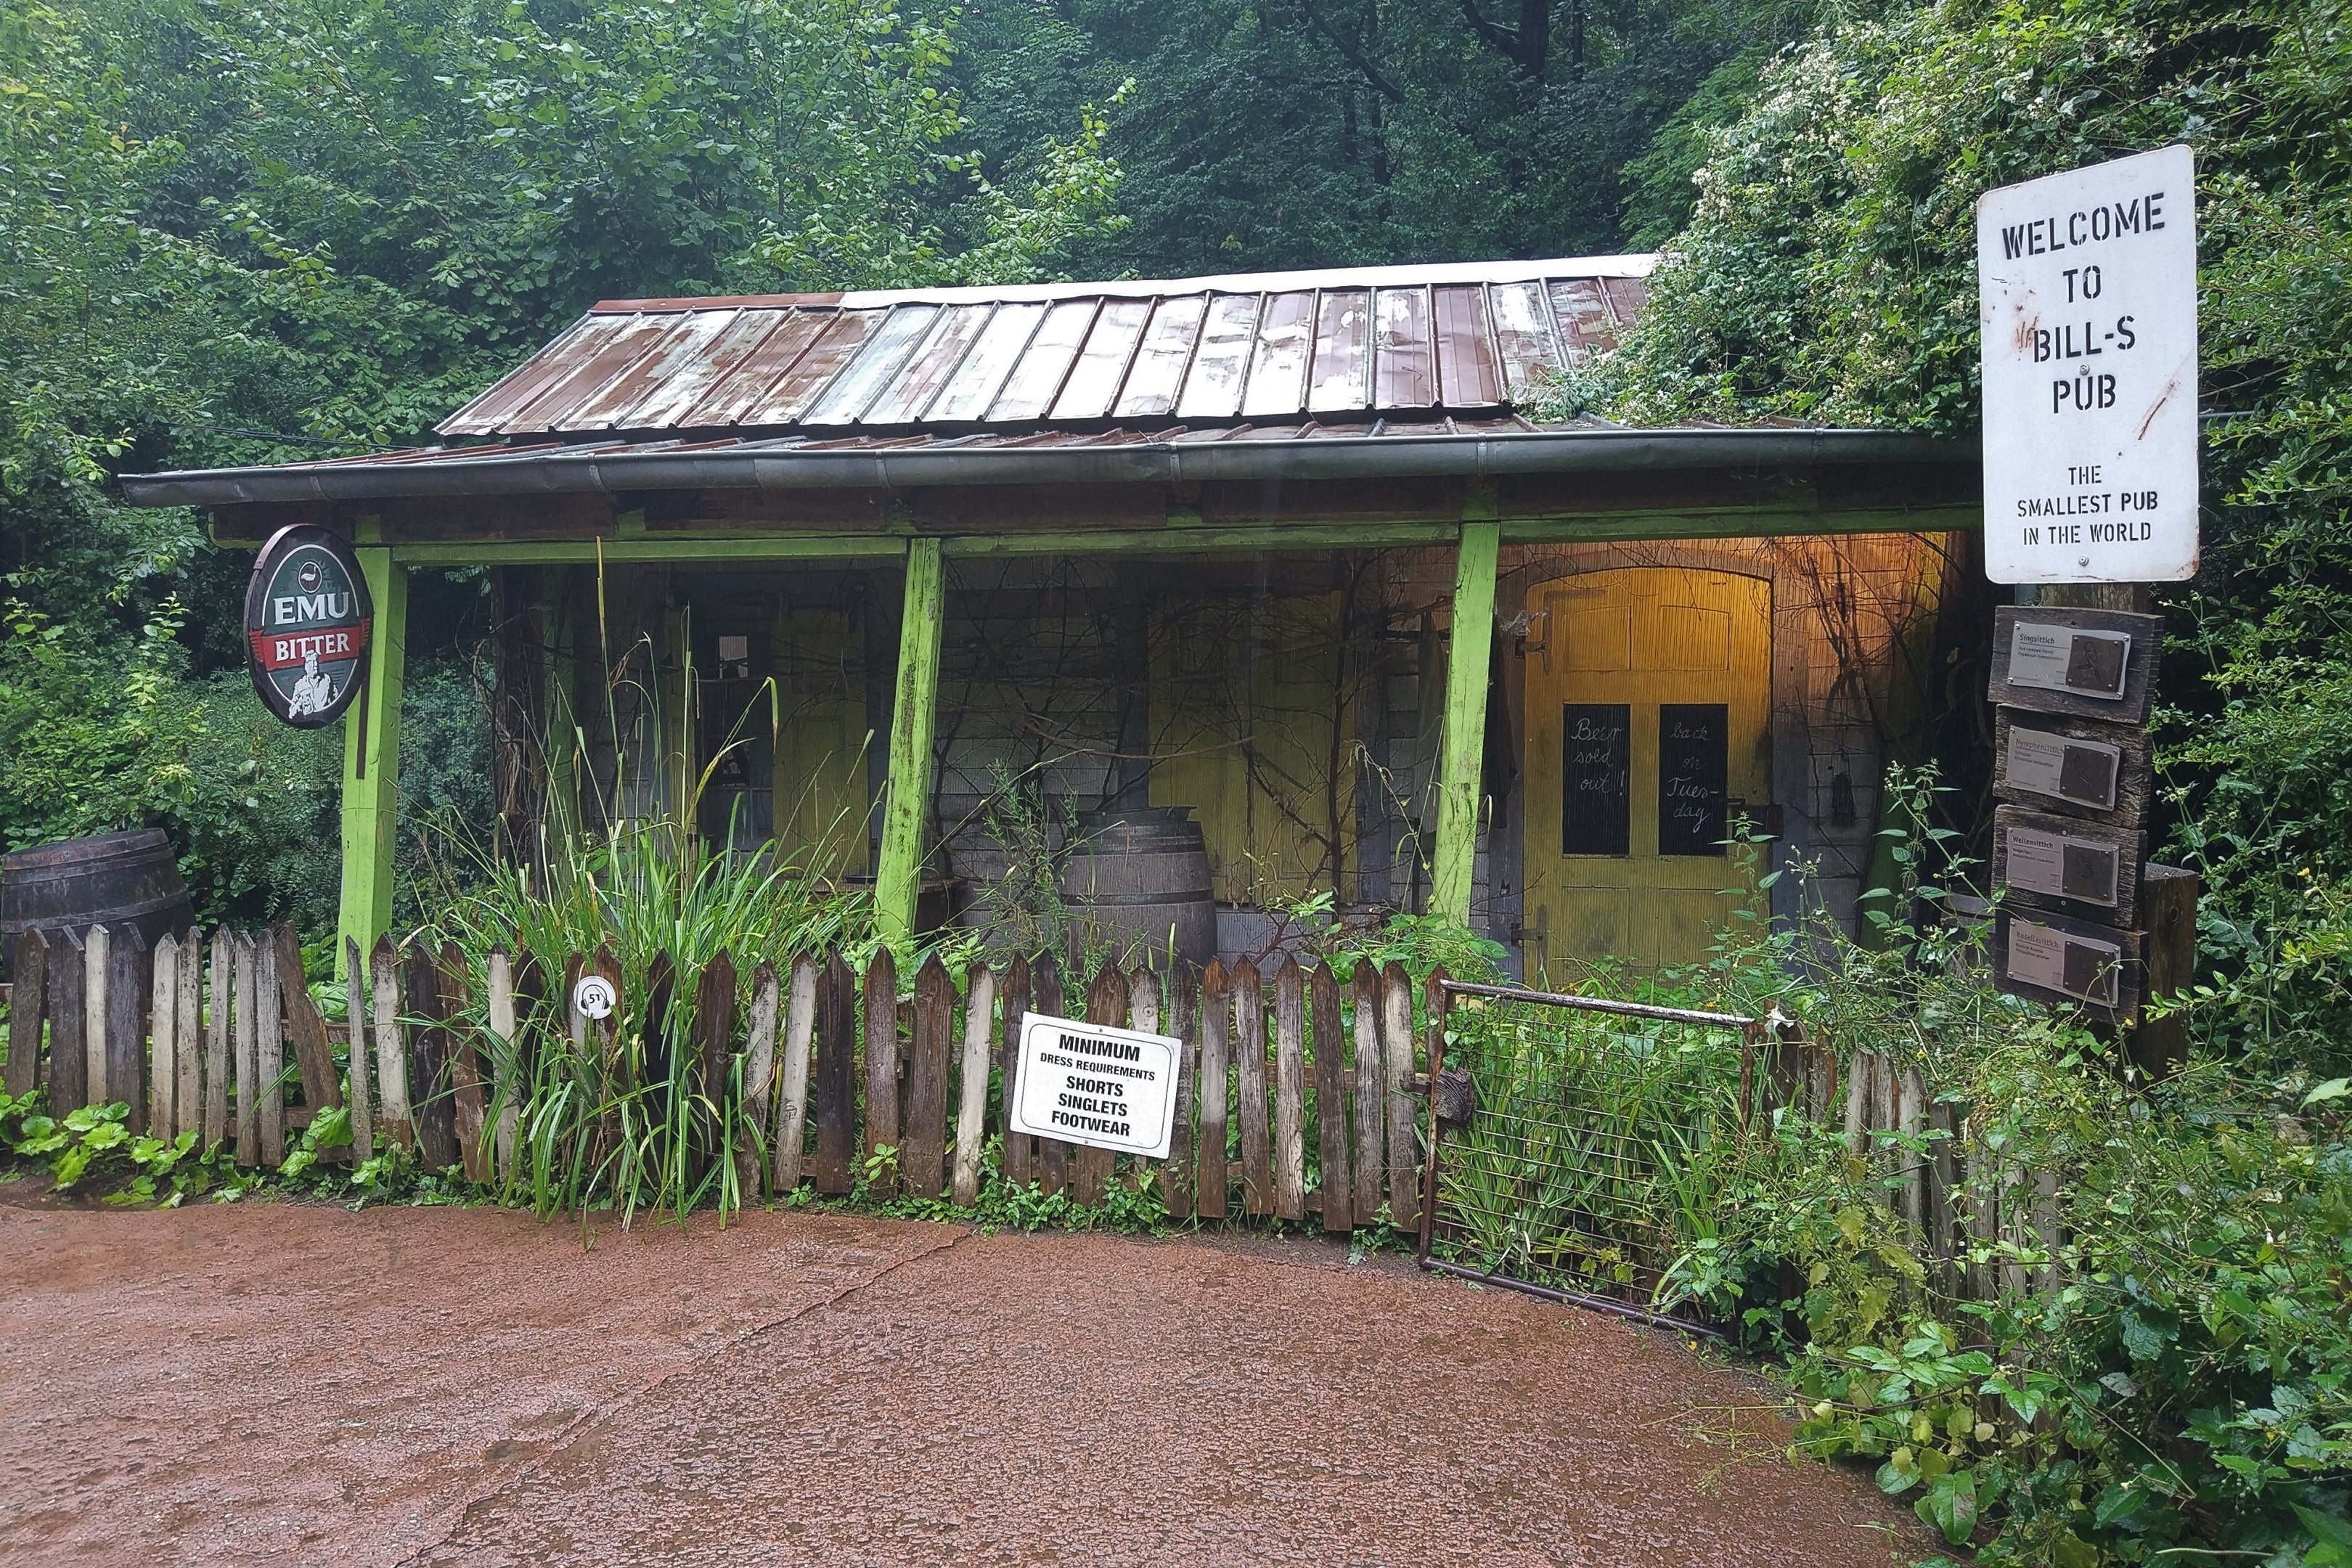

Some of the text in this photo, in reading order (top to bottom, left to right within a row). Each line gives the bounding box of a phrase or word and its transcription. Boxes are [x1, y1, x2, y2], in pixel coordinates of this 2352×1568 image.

[2002, 192, 2165, 260] WELCOME
[2062, 266, 2102, 303] TO
[2053, 374, 2116, 413] PUB
[2068, 465, 2102, 486] THE
[2017, 491, 2158, 518] SMALLEST PUB
[2023, 521, 2152, 545] IN THE WORLD
[273, 592, 350, 626] EMU
[275, 632, 351, 662] BITTER
[2020, 633, 2055, 645] Singsittich
[1572, 748, 1614, 767] sold
[1683, 756, 1706, 770] on
[1673, 802, 1712, 833] day
[2012, 836, 2054, 849] Wellensittich
[589, 994, 600, 1004] 51
[1058, 1034, 1140, 1062] MINIMUM
[1040, 1053, 1156, 1081] DRESS REQUIREMENTS
[1066, 1075, 1124, 1097] SHORTS
[1058, 1093, 1128, 1116] SINGLETS
[1051, 1110, 1130, 1137] FOOTWEAR
